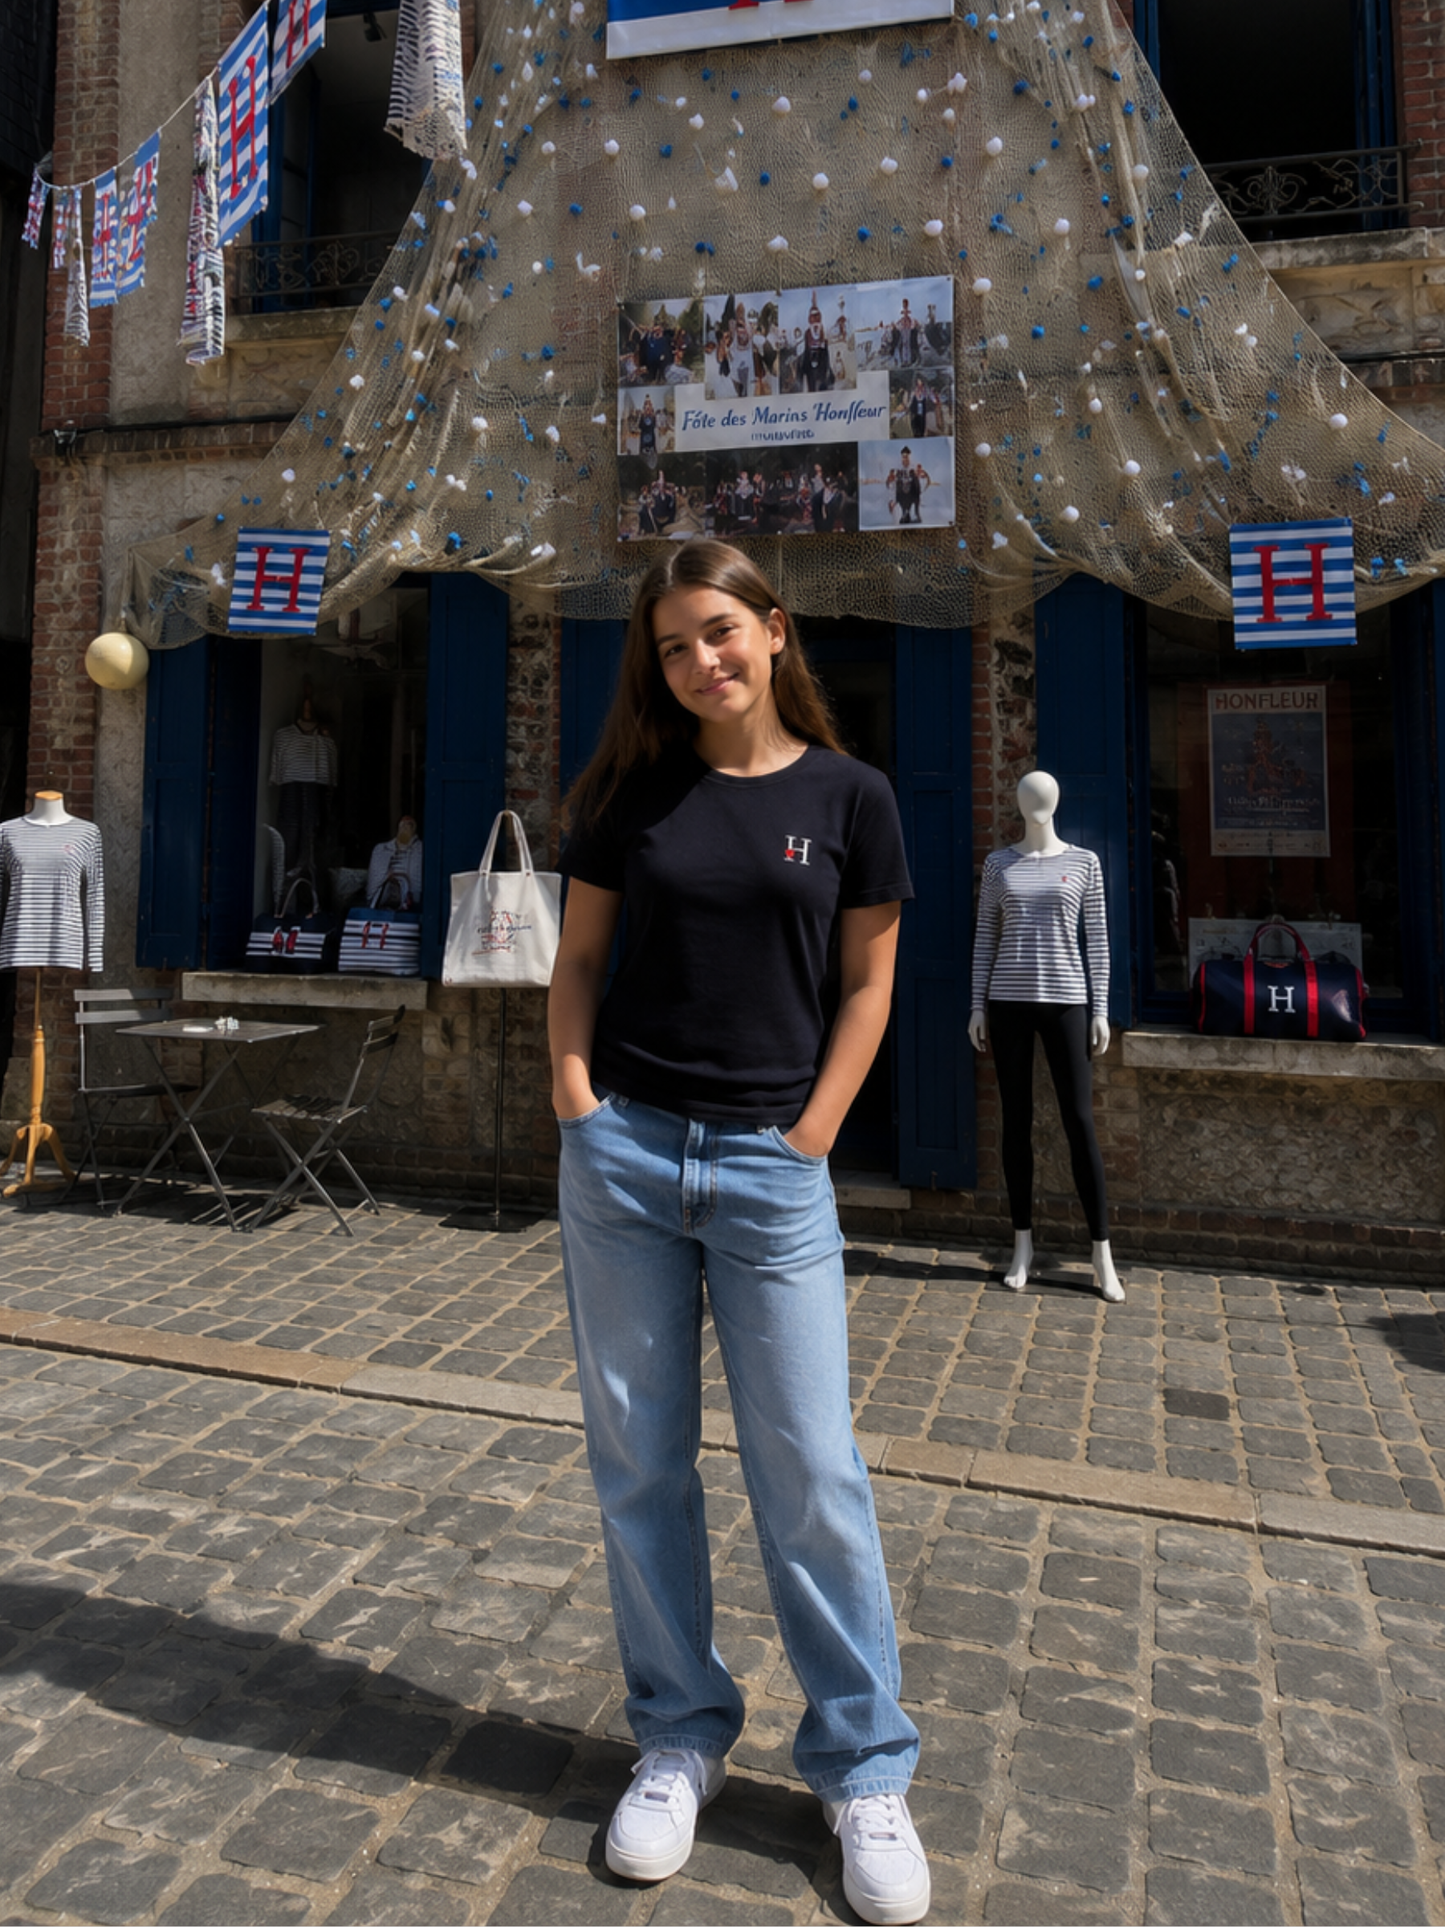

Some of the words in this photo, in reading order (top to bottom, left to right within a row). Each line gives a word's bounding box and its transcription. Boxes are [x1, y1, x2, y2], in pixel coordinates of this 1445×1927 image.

[228, 55, 259, 200] H
[721, 409, 746, 427] des
[752, 406, 807, 425] Marins
[246, 546, 312, 612] H
[1253, 543, 1333, 623] H
[783, 834, 812, 866] H
[1267, 985, 1296, 1013] H
